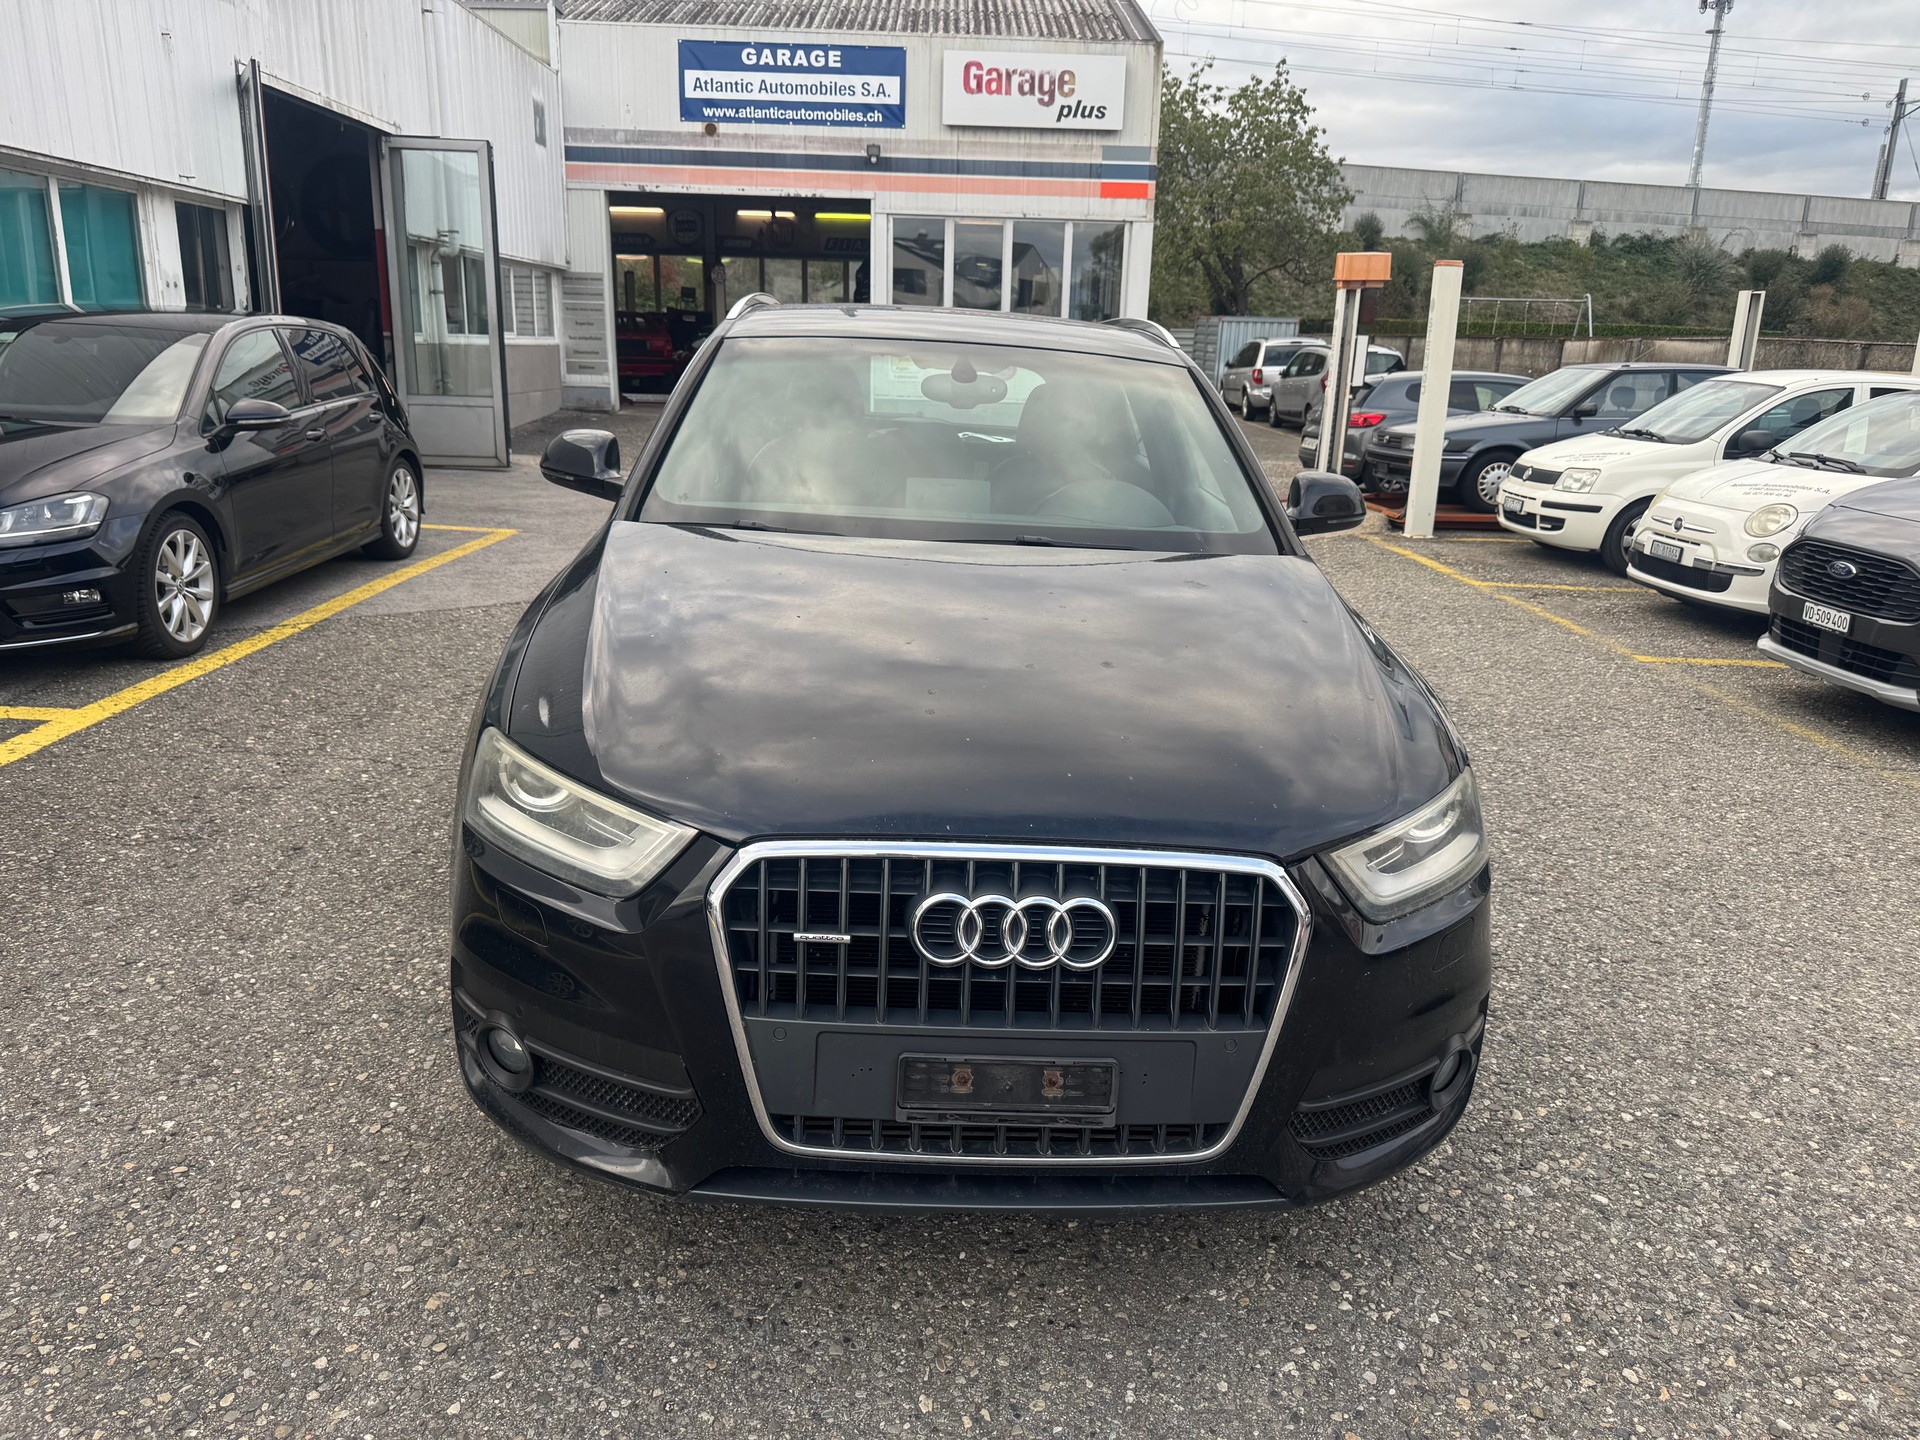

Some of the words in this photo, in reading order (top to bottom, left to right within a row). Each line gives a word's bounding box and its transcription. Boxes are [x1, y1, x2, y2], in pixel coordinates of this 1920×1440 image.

[741, 48, 842, 68] GARAGE
[693, 76, 754, 94] Atlantic
[758, 78, 856, 97] Automobiles
[861, 82, 891, 98] S.A.
[962, 60, 1076, 107] Garage
[702, 105, 883, 123] www.atlanticautomobiles.ch
[1056, 99, 1108, 123] plus
